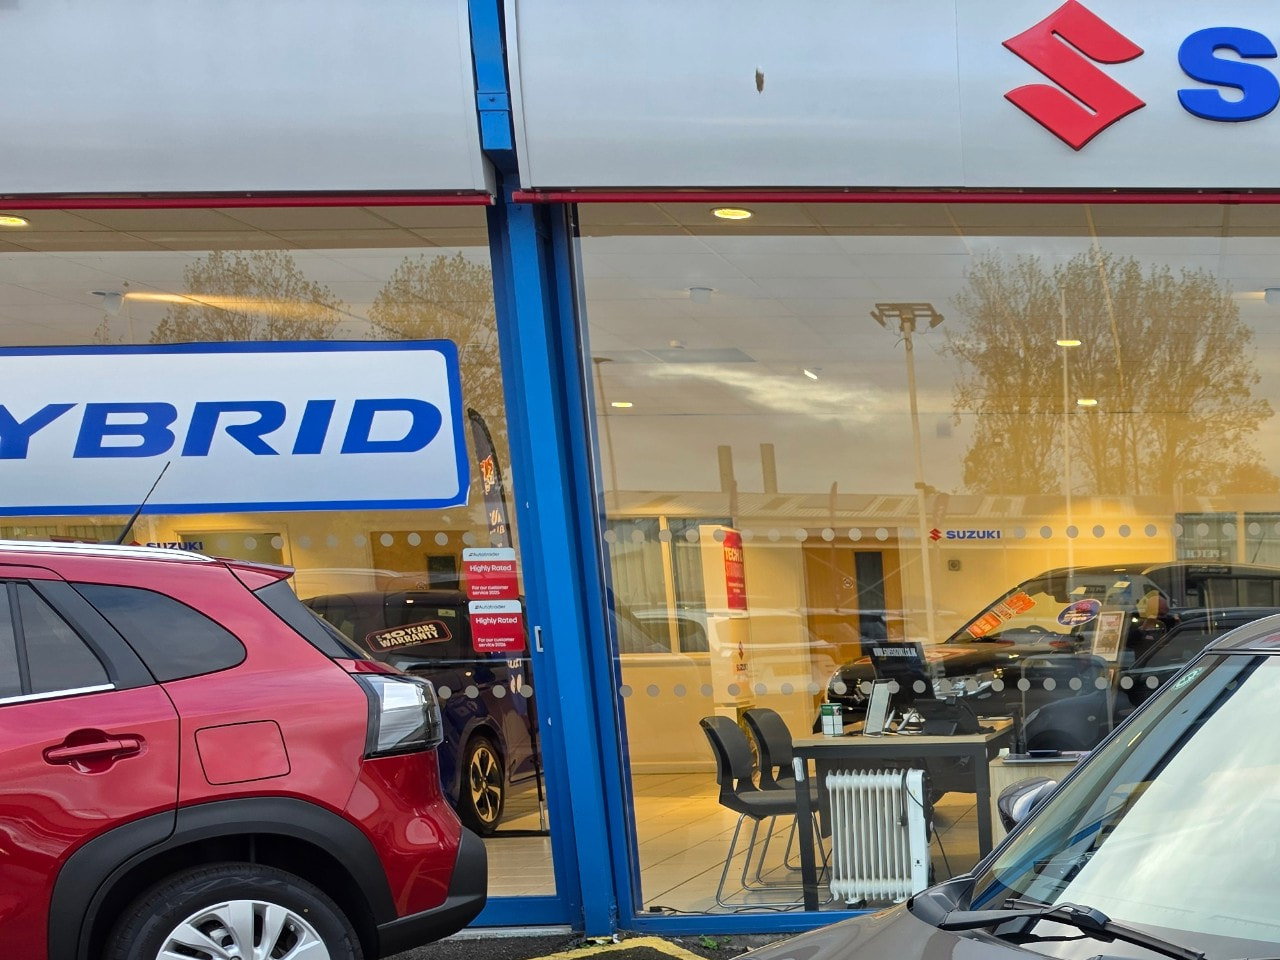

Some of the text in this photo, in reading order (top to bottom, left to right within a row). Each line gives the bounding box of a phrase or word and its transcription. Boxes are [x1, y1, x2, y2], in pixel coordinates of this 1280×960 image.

[946, 530, 1001, 539] SUZUKI
[469, 564, 491, 573] Highly
[475, 616, 518, 626] Highly Rated
[382, 630, 406, 640] 10
[404, 624, 437, 635] YEARS
[379, 630, 439, 648] WARRANTY
